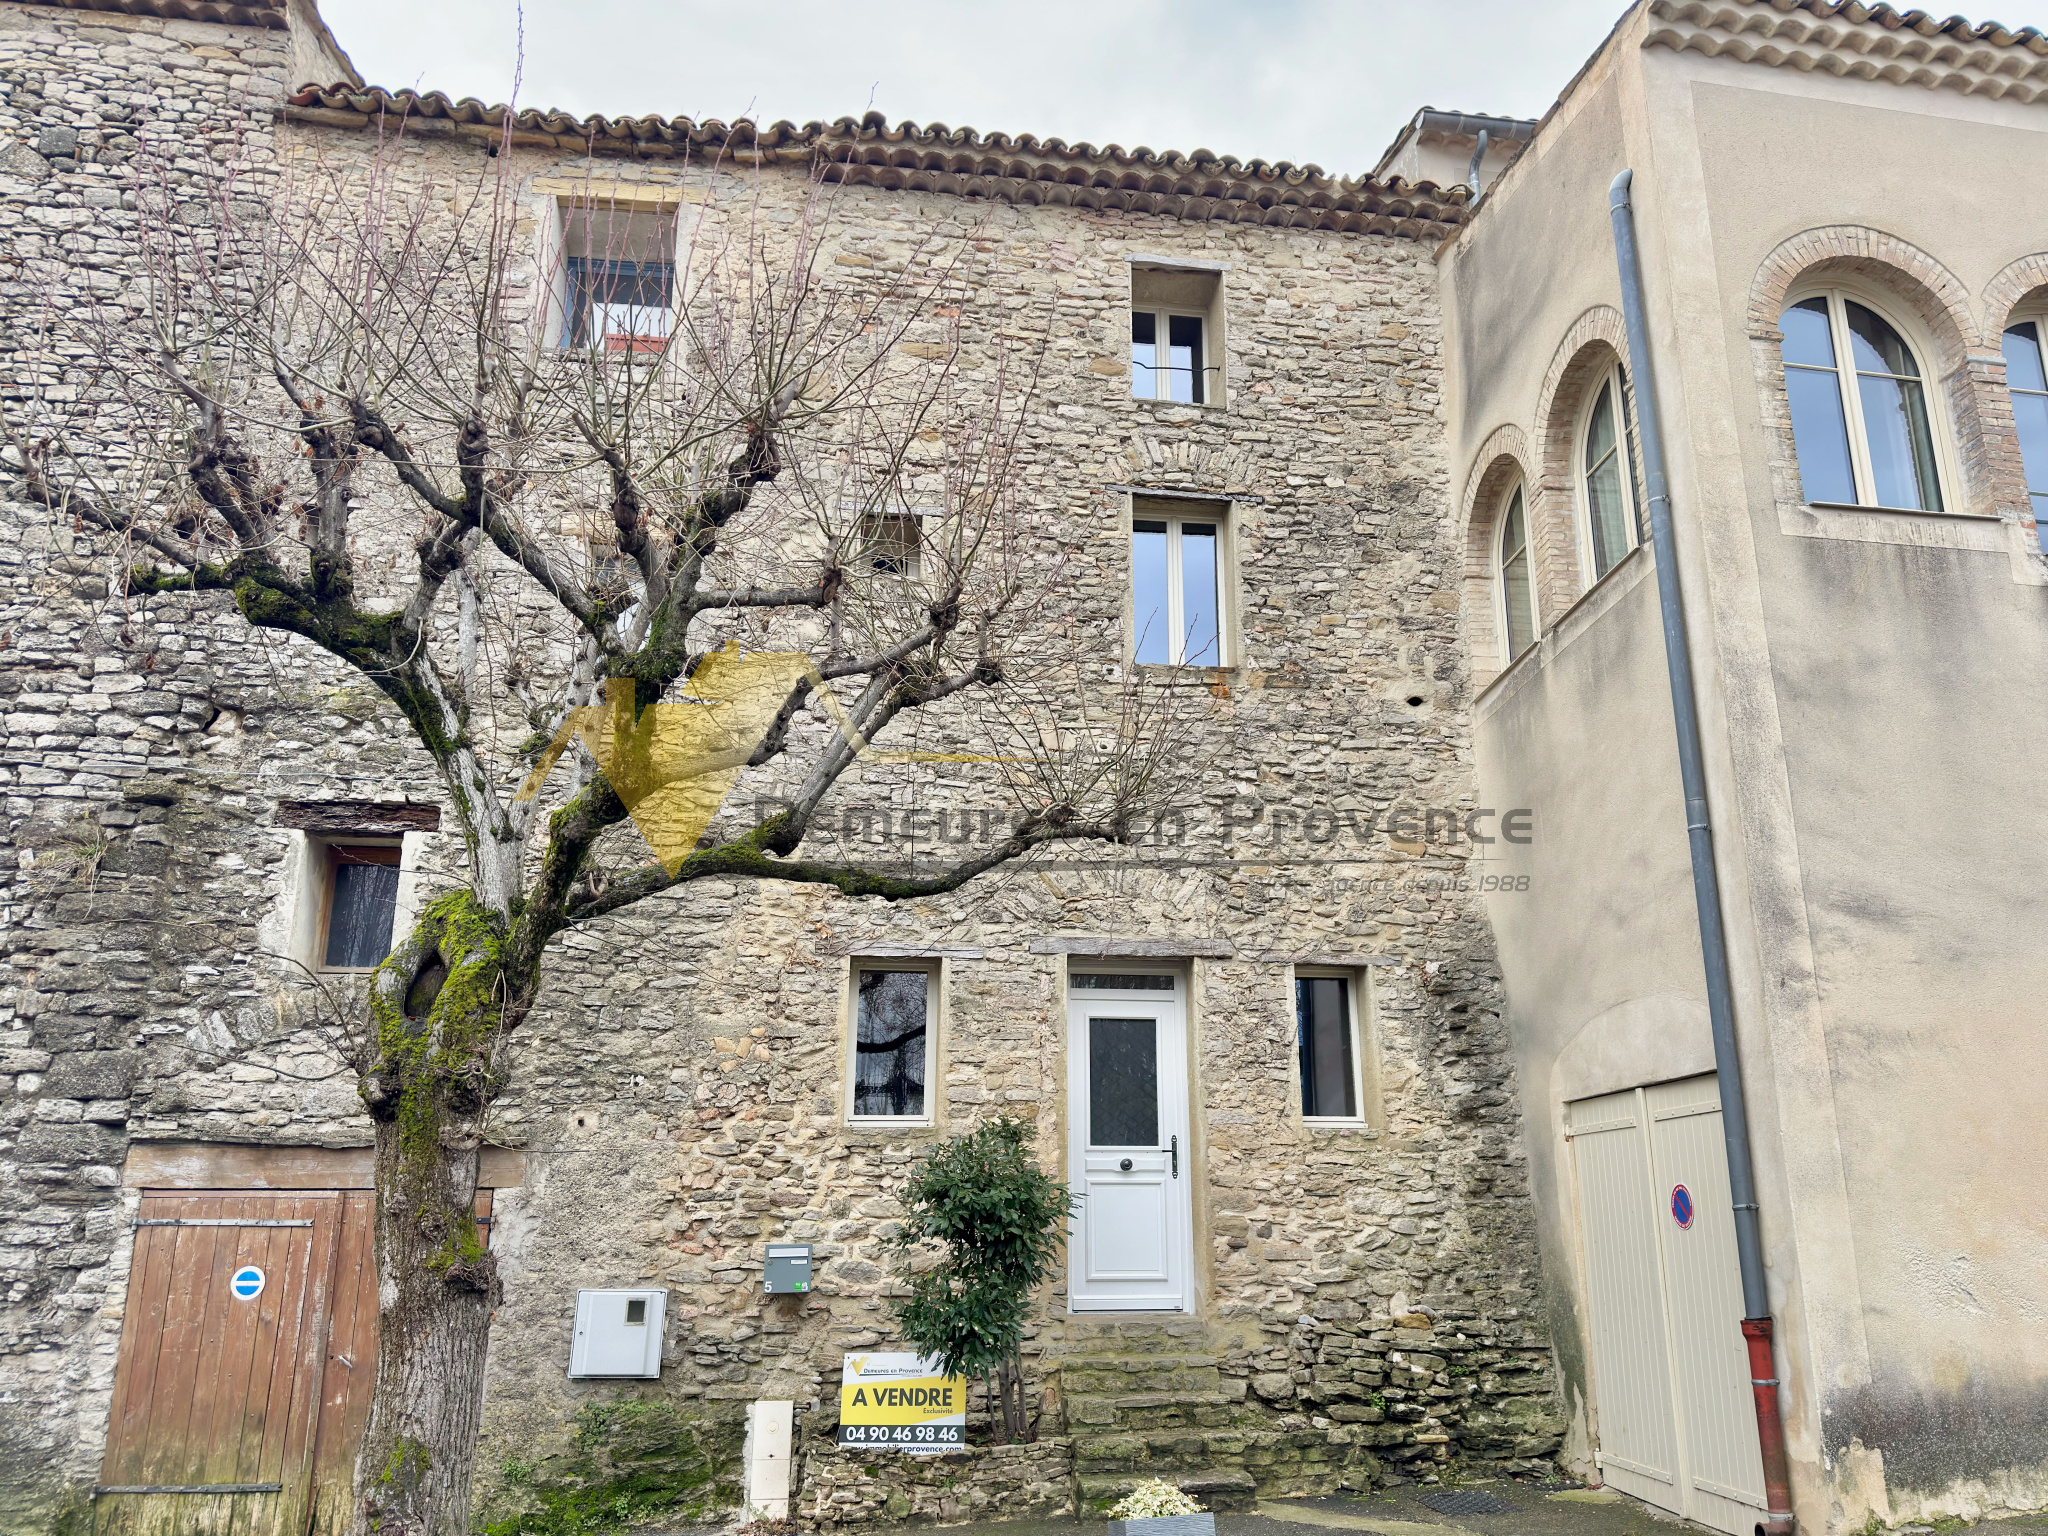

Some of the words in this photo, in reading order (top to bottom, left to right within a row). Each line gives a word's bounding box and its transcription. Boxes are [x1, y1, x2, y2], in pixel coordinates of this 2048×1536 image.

[764, 1281, 773, 1293] 5
[851, 1387, 868, 1407] A
[873, 1387, 953, 1407] VENDRE
[846, 1426, 866, 1441] 04
[869, 1426, 889, 1441] 90
[892, 1426, 912, 1441] 46
[915, 1426, 935, 1441] 98
[938, 1426, 958, 1441] 46
